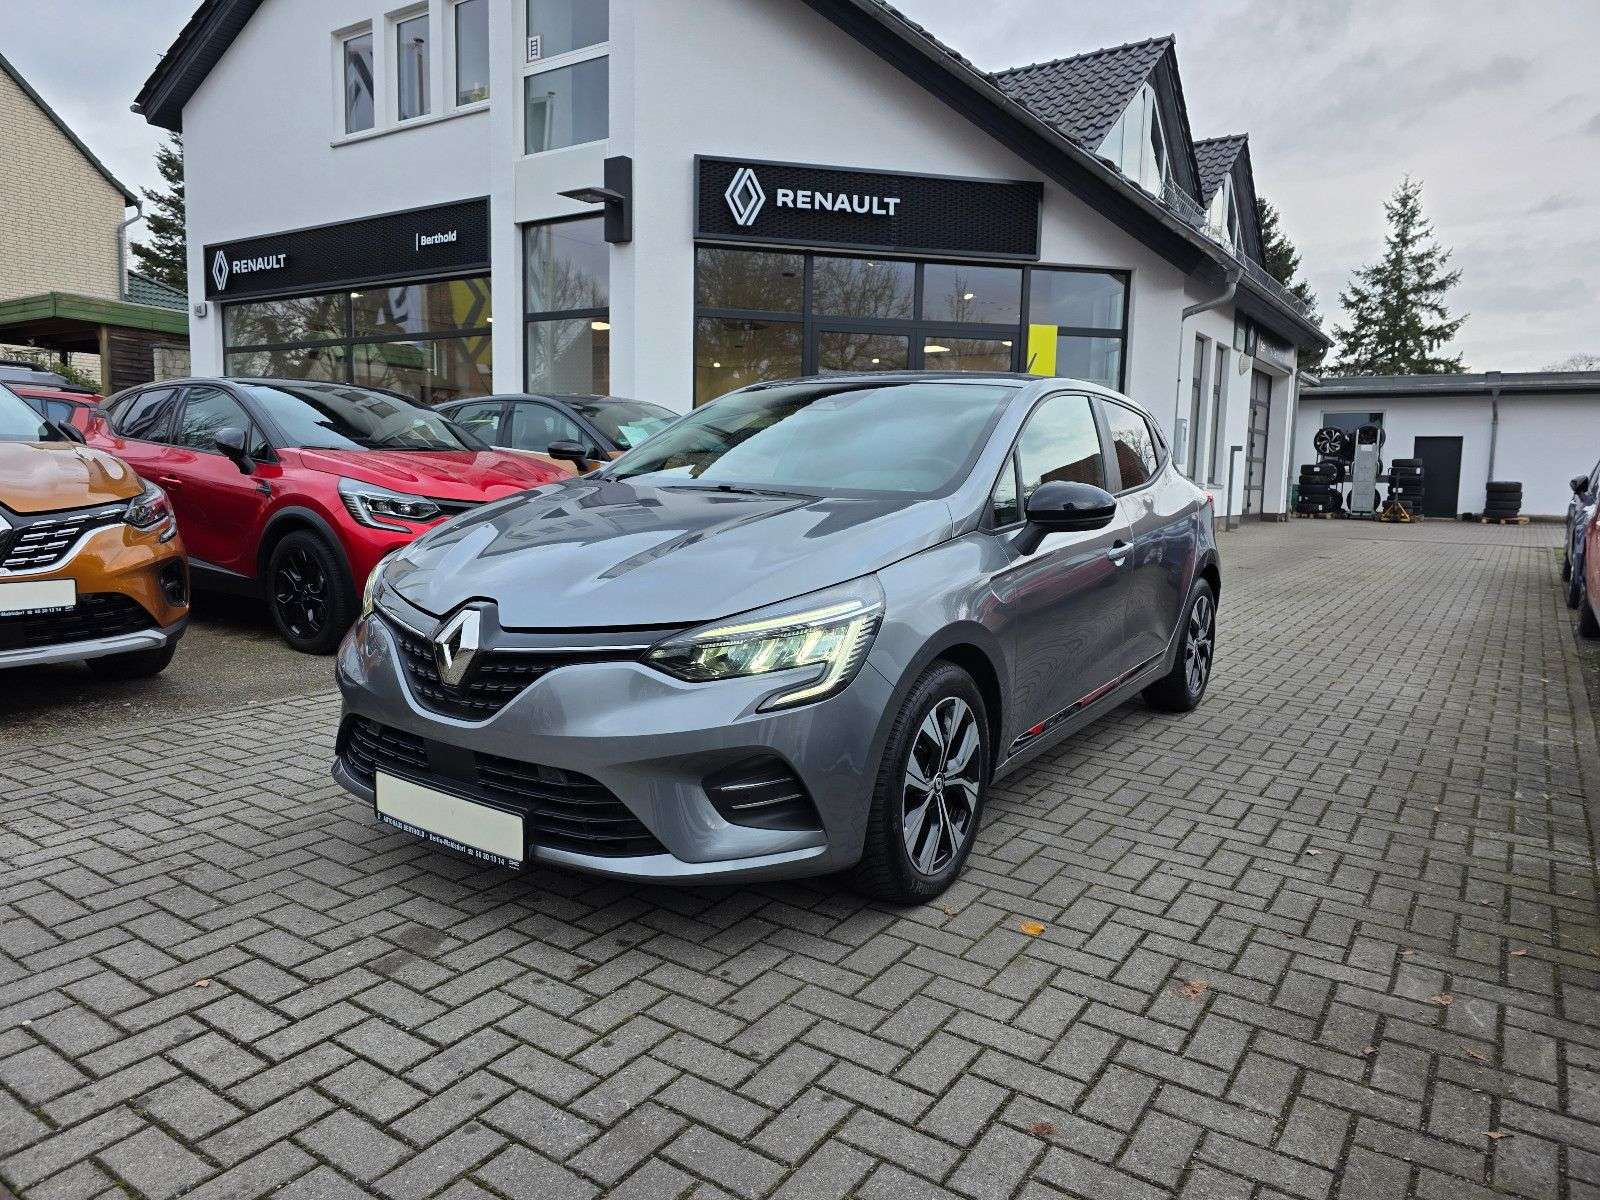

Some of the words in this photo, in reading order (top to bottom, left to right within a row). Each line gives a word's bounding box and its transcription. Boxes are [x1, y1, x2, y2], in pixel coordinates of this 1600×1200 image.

[776, 188, 900, 216] RENAULT
[420, 230, 457, 246] Berthold
[232, 253, 287, 274] RENAULT
